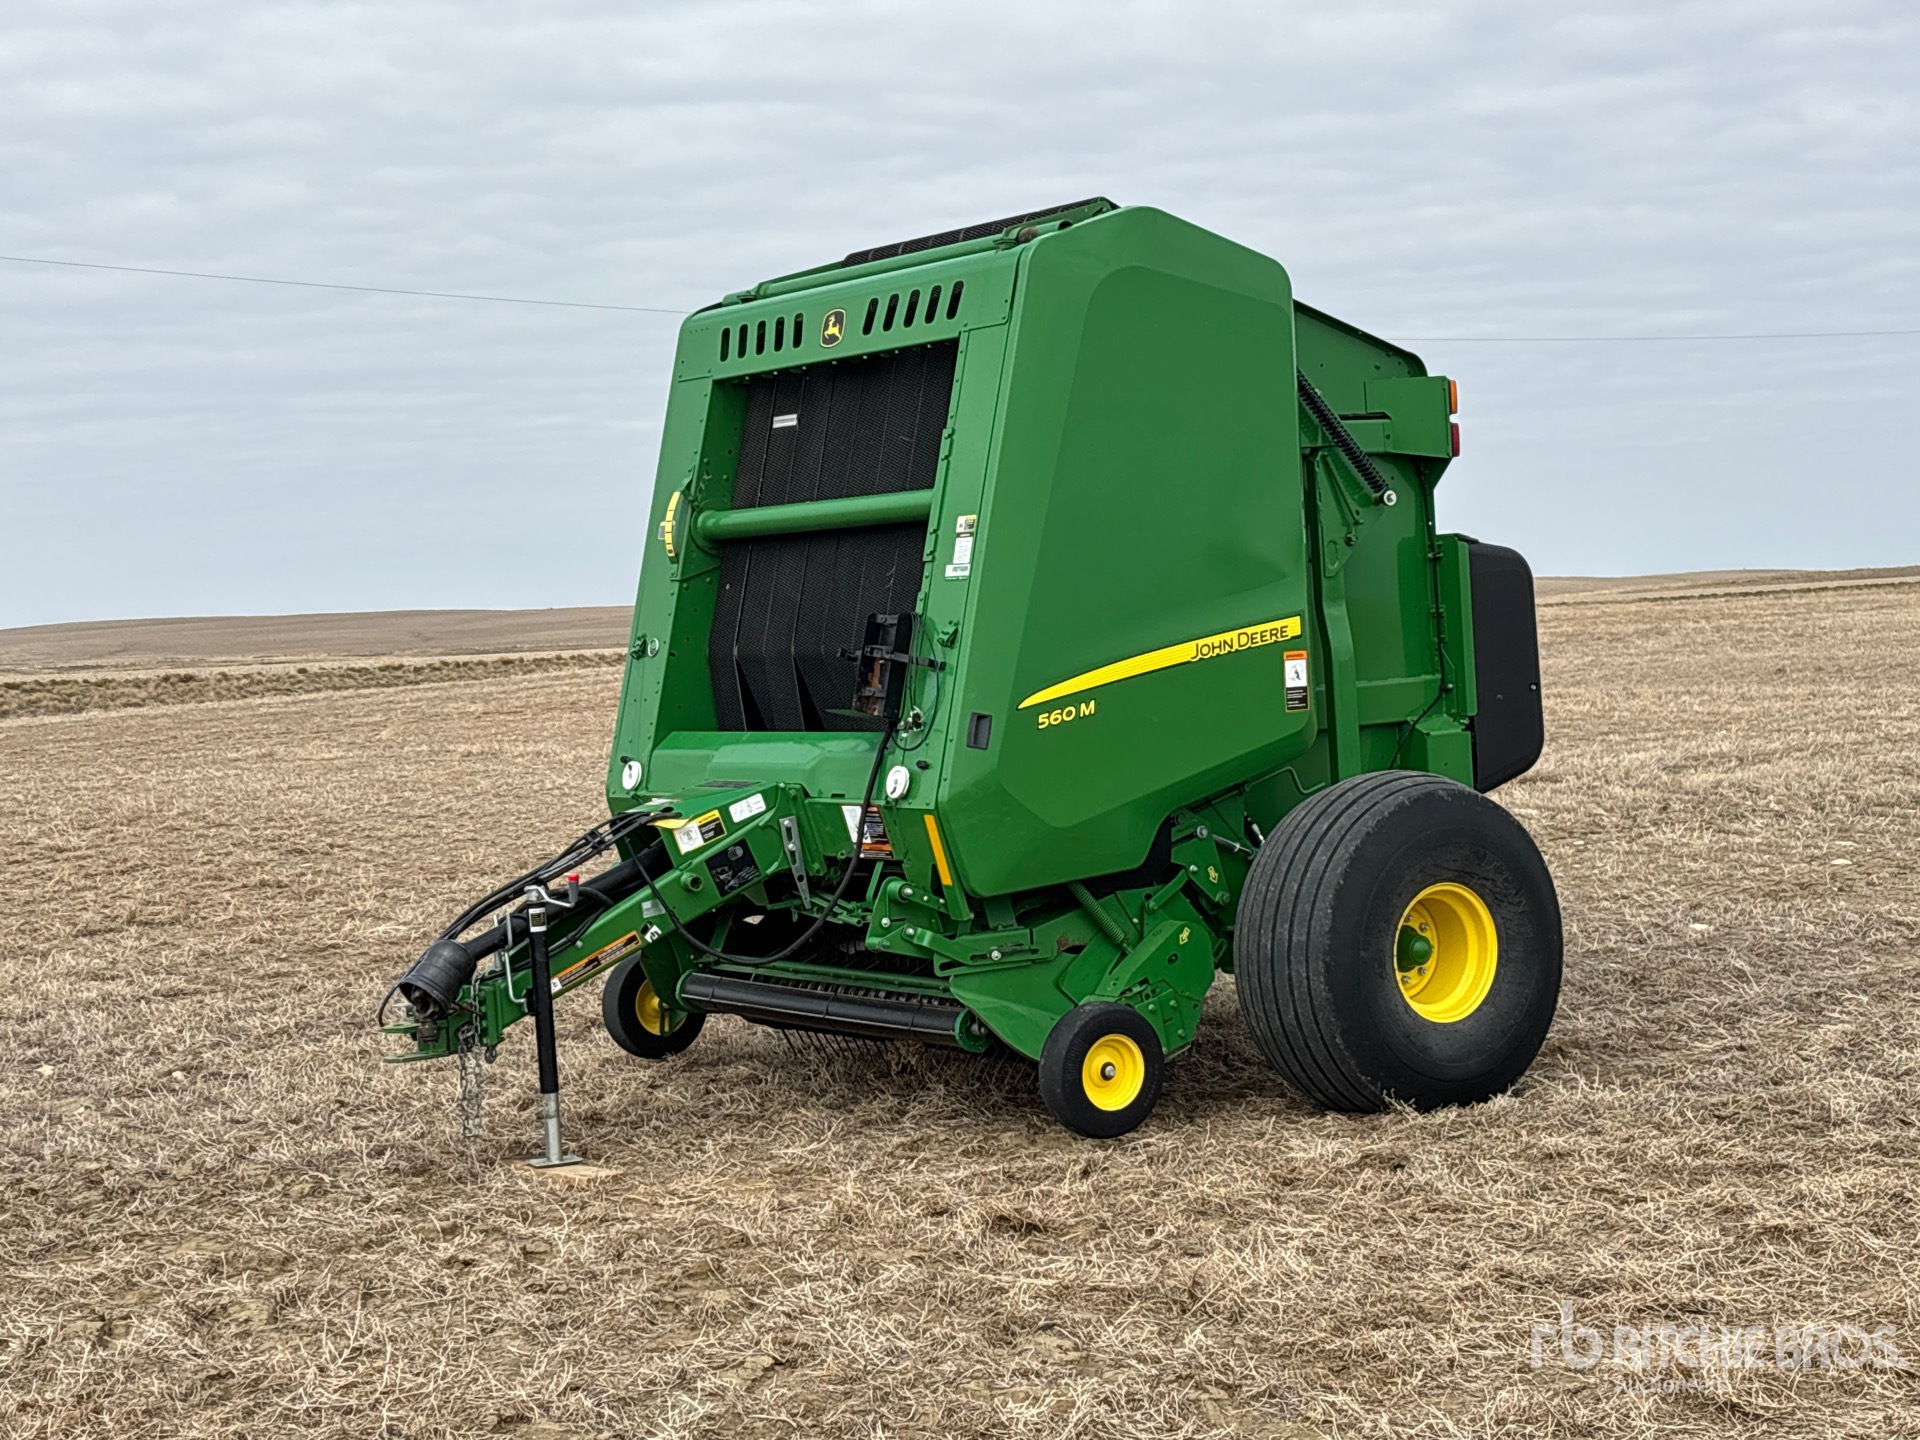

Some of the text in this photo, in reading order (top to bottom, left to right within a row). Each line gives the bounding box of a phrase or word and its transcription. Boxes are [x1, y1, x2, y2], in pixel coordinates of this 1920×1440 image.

[1191, 624, 1290, 660] JOHN DEERE
[1037, 700, 1096, 730] 560 M
